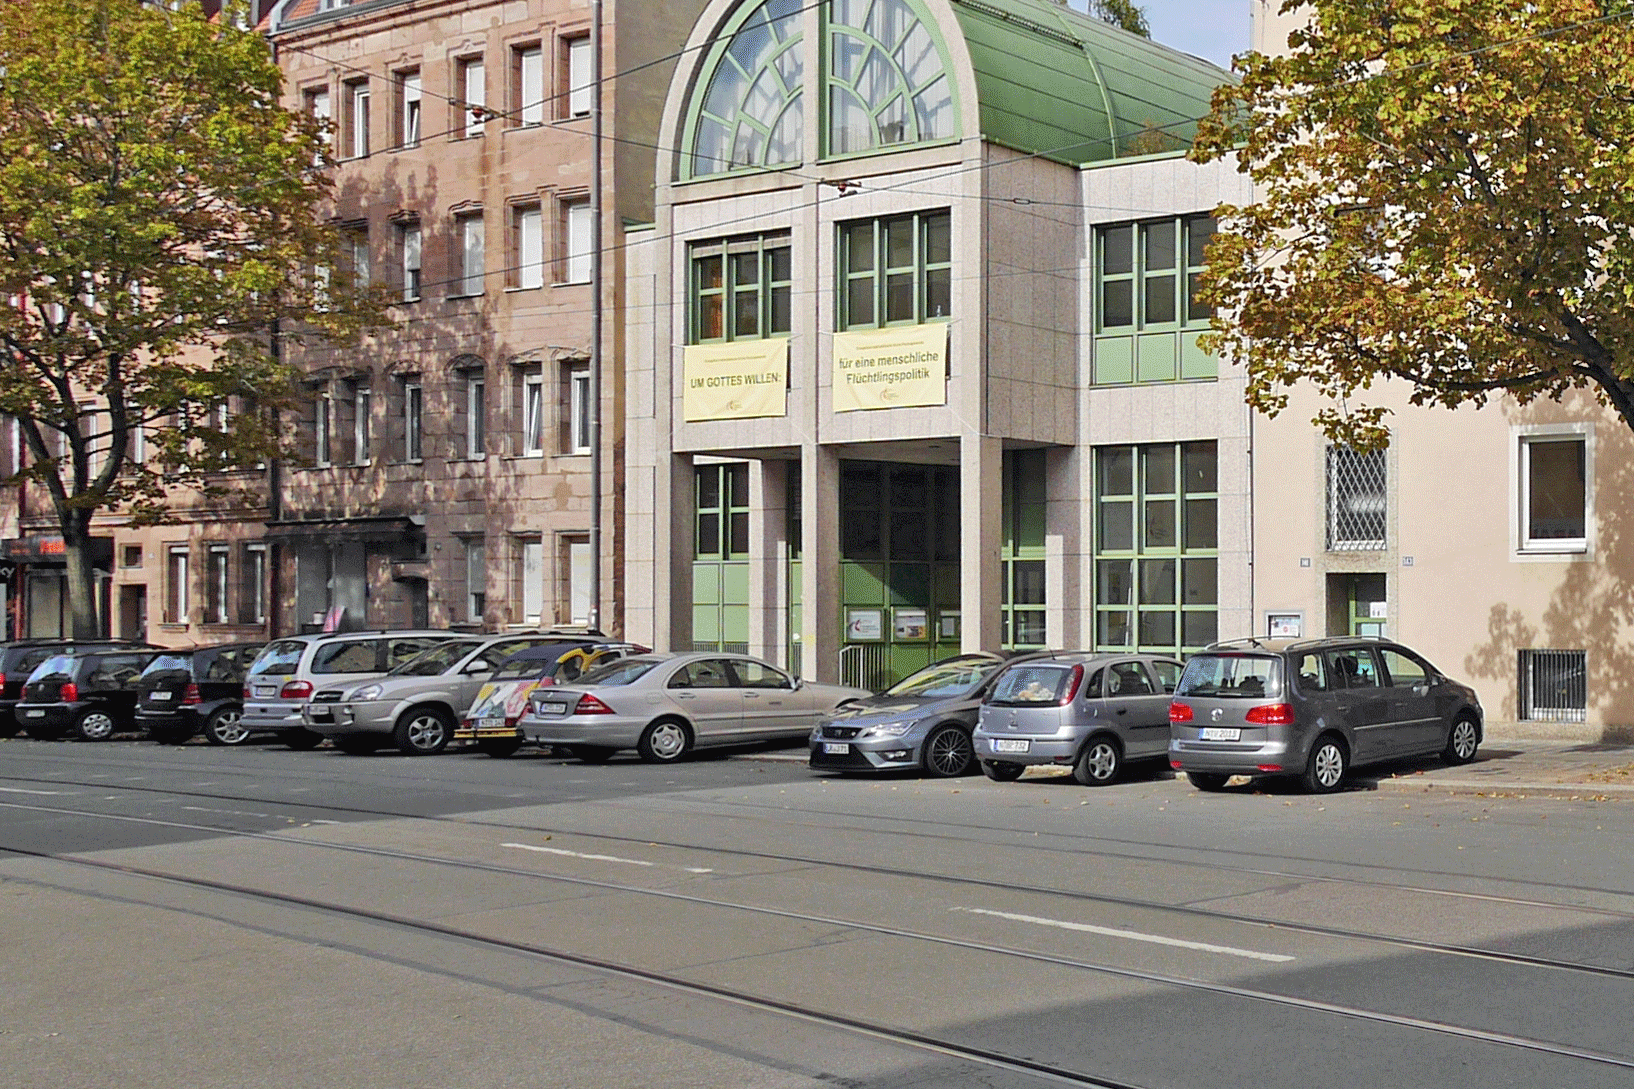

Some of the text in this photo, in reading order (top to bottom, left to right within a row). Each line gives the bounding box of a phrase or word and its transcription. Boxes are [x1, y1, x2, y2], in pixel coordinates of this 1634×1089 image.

[839, 351, 939, 369] für eine menschliche
[690, 372, 782, 389] UM GOTTES WILLEN:
[846, 368, 930, 384] Flüchtlingspolitik
